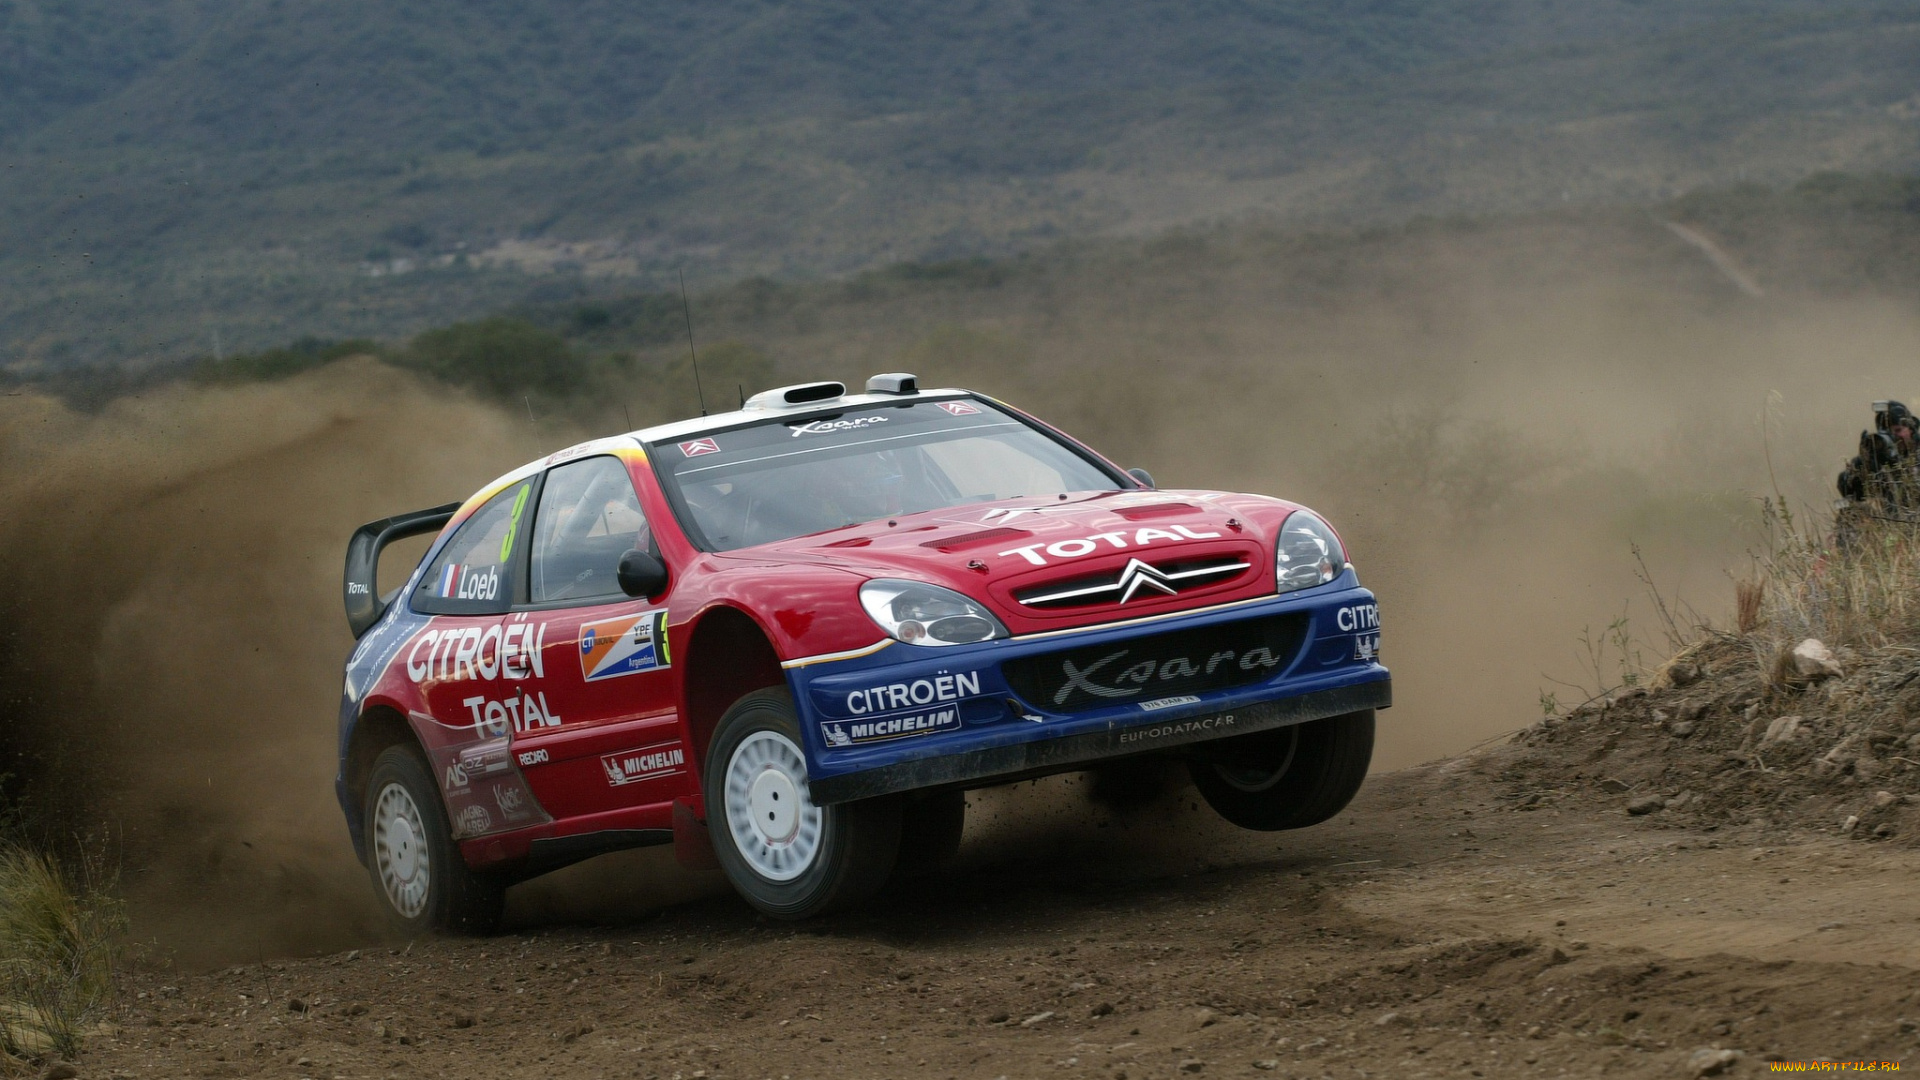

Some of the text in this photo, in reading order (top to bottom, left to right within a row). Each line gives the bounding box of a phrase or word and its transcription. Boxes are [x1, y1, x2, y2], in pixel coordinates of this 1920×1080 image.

[789, 416, 888, 437] Xsara
[500, 483, 529, 563] 3
[997, 524, 1222, 565] TOTAL
[458, 565, 498, 600] Loeb
[407, 612, 546, 683] CITROËN
[634, 624, 652, 637] YPF
[847, 670, 981, 715] CITROËN
[1054, 646, 1281, 704] Xsara
[463, 691, 561, 740] TOTAL
[851, 709, 955, 738] MICHELIN
[518, 749, 549, 766] RECARO
[624, 748, 684, 774] MICHELIN
